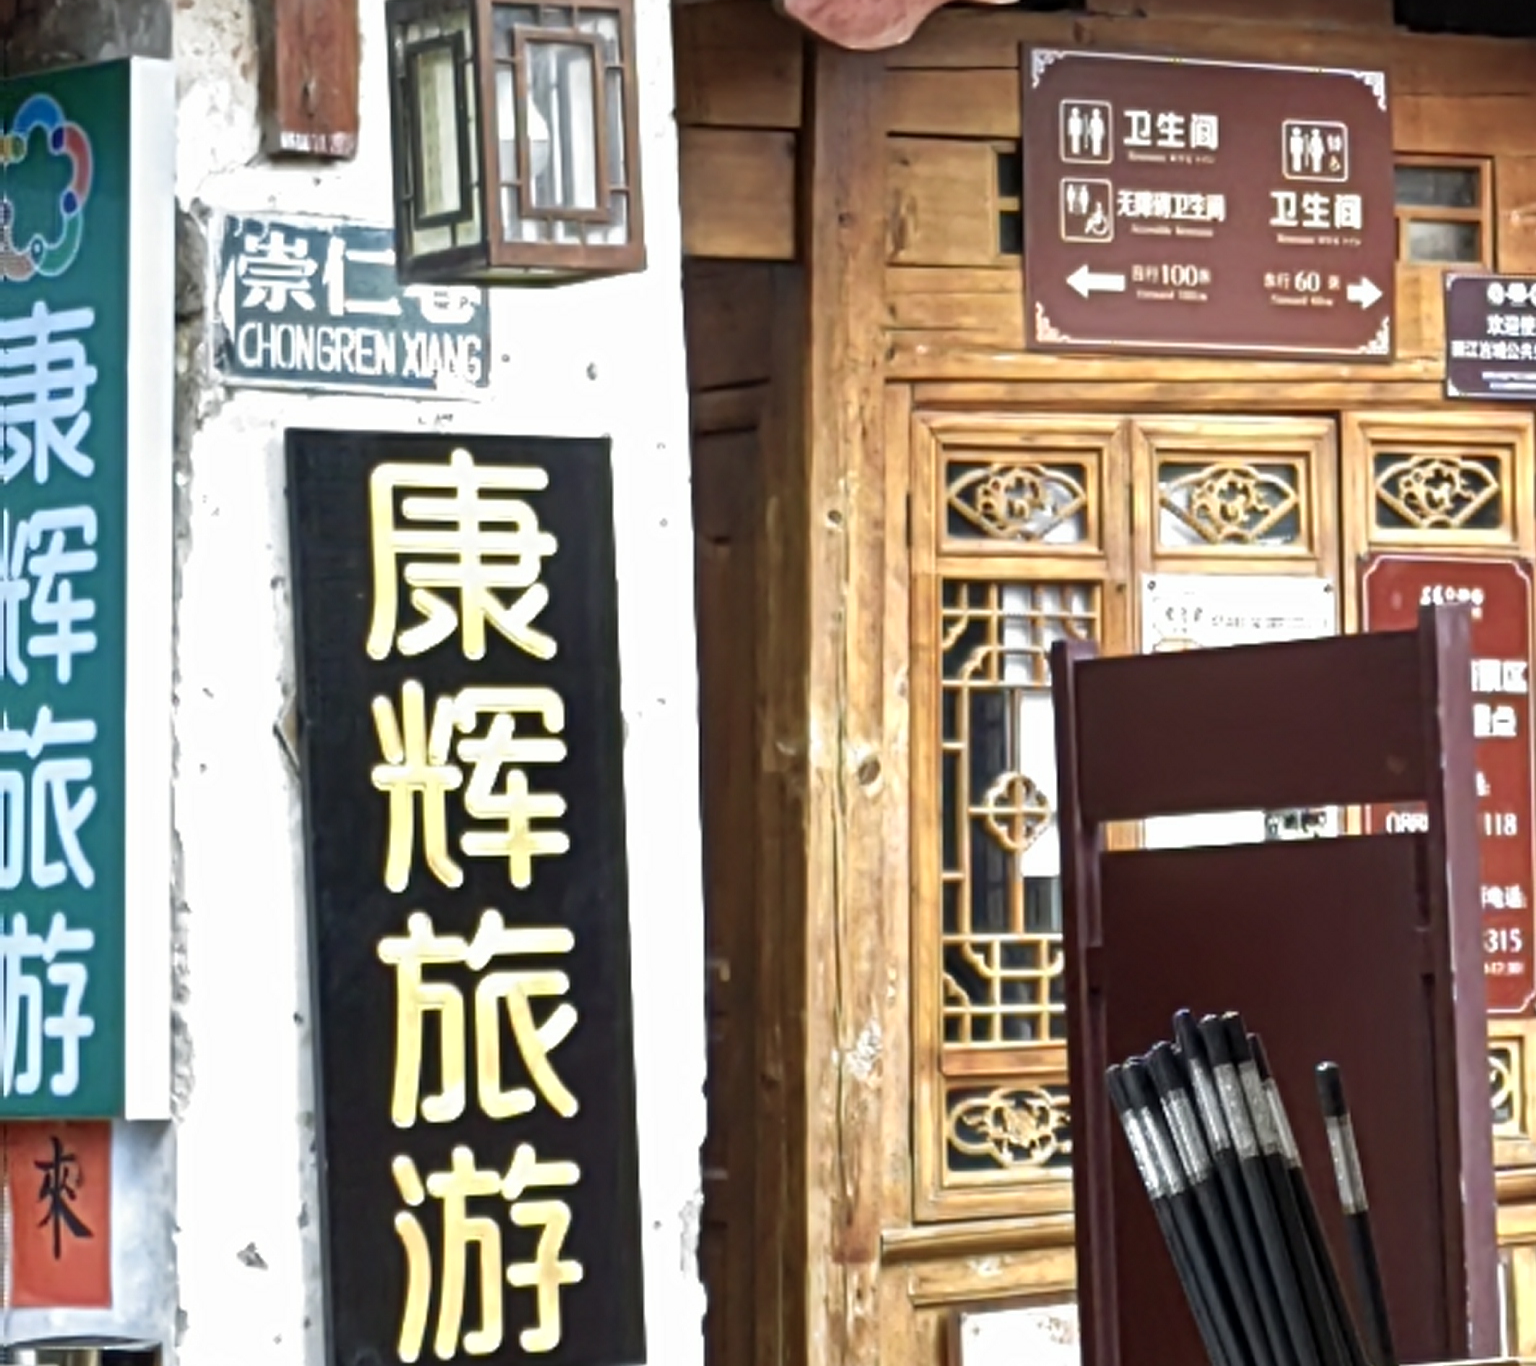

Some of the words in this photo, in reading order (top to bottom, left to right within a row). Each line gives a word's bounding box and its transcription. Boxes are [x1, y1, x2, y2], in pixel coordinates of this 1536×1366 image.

[1123, 109, 1219, 150] 卫生间
[1269, 191, 1362, 229] 卫生间
[237, 322, 397, 377] CHONGREN
[402, 330, 482, 385] XIANG
[0, 300, 98, 1098] 康辉旅游
[366, 447, 585, 1363] 康辉旅游
[1484, 927, 1523, 954] 315
